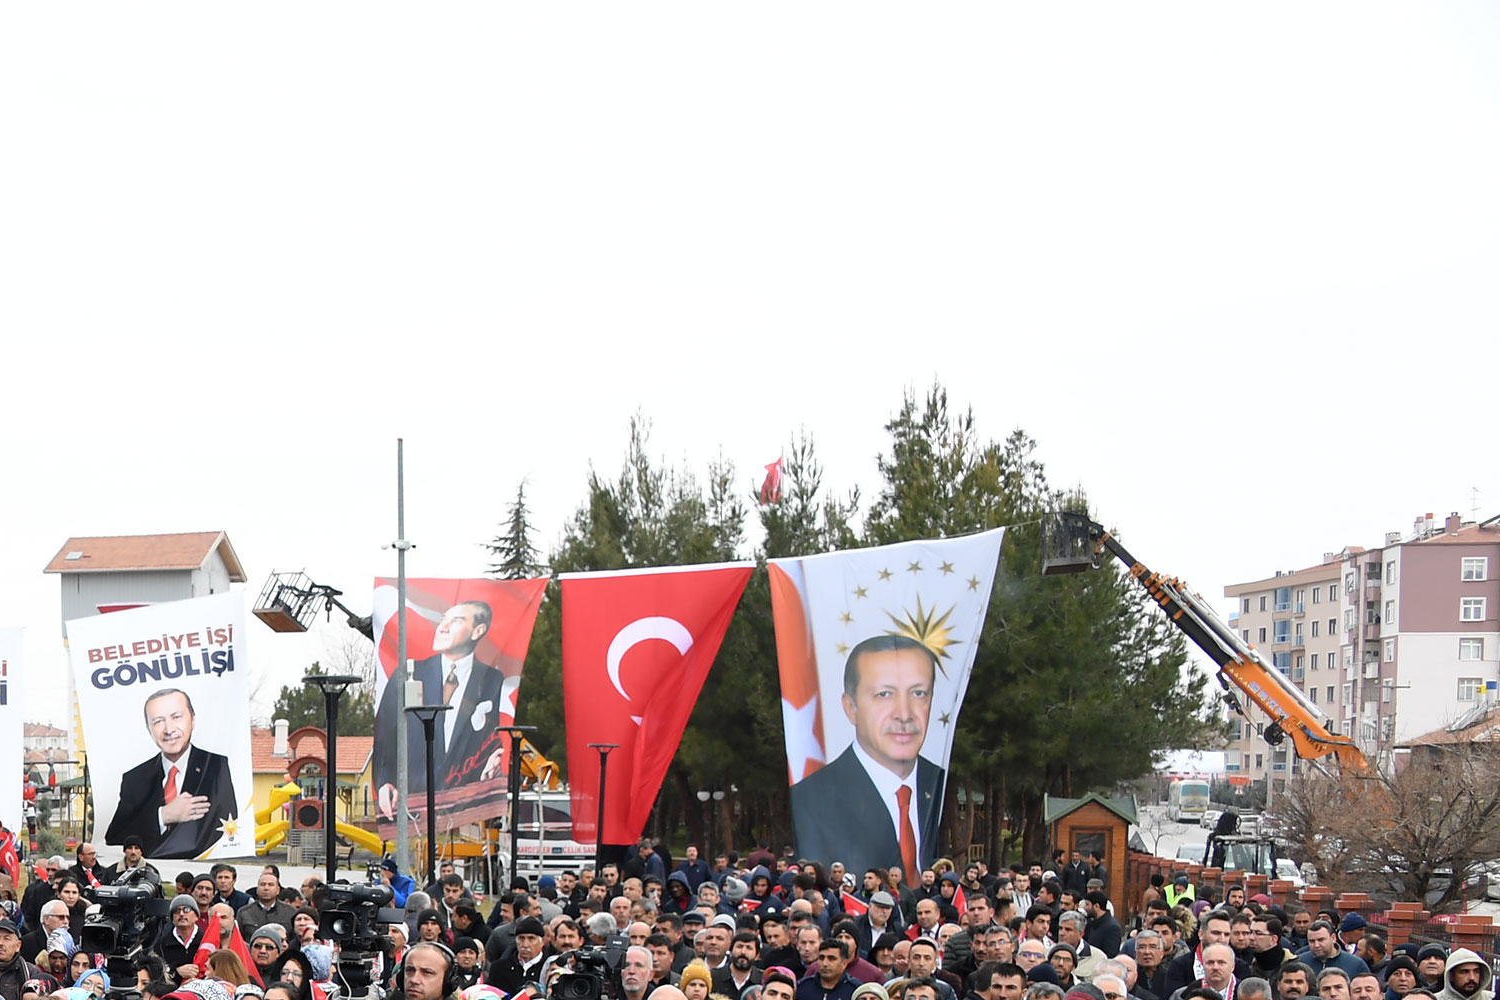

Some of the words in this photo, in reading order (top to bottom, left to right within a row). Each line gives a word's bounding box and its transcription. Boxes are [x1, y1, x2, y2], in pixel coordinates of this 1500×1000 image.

[88, 634, 200, 663] BELEDİYE
[206, 624, 233, 646] İŞİ
[91, 652, 200, 689] GÖNÜL
[201, 645, 234, 677] İŞİ
